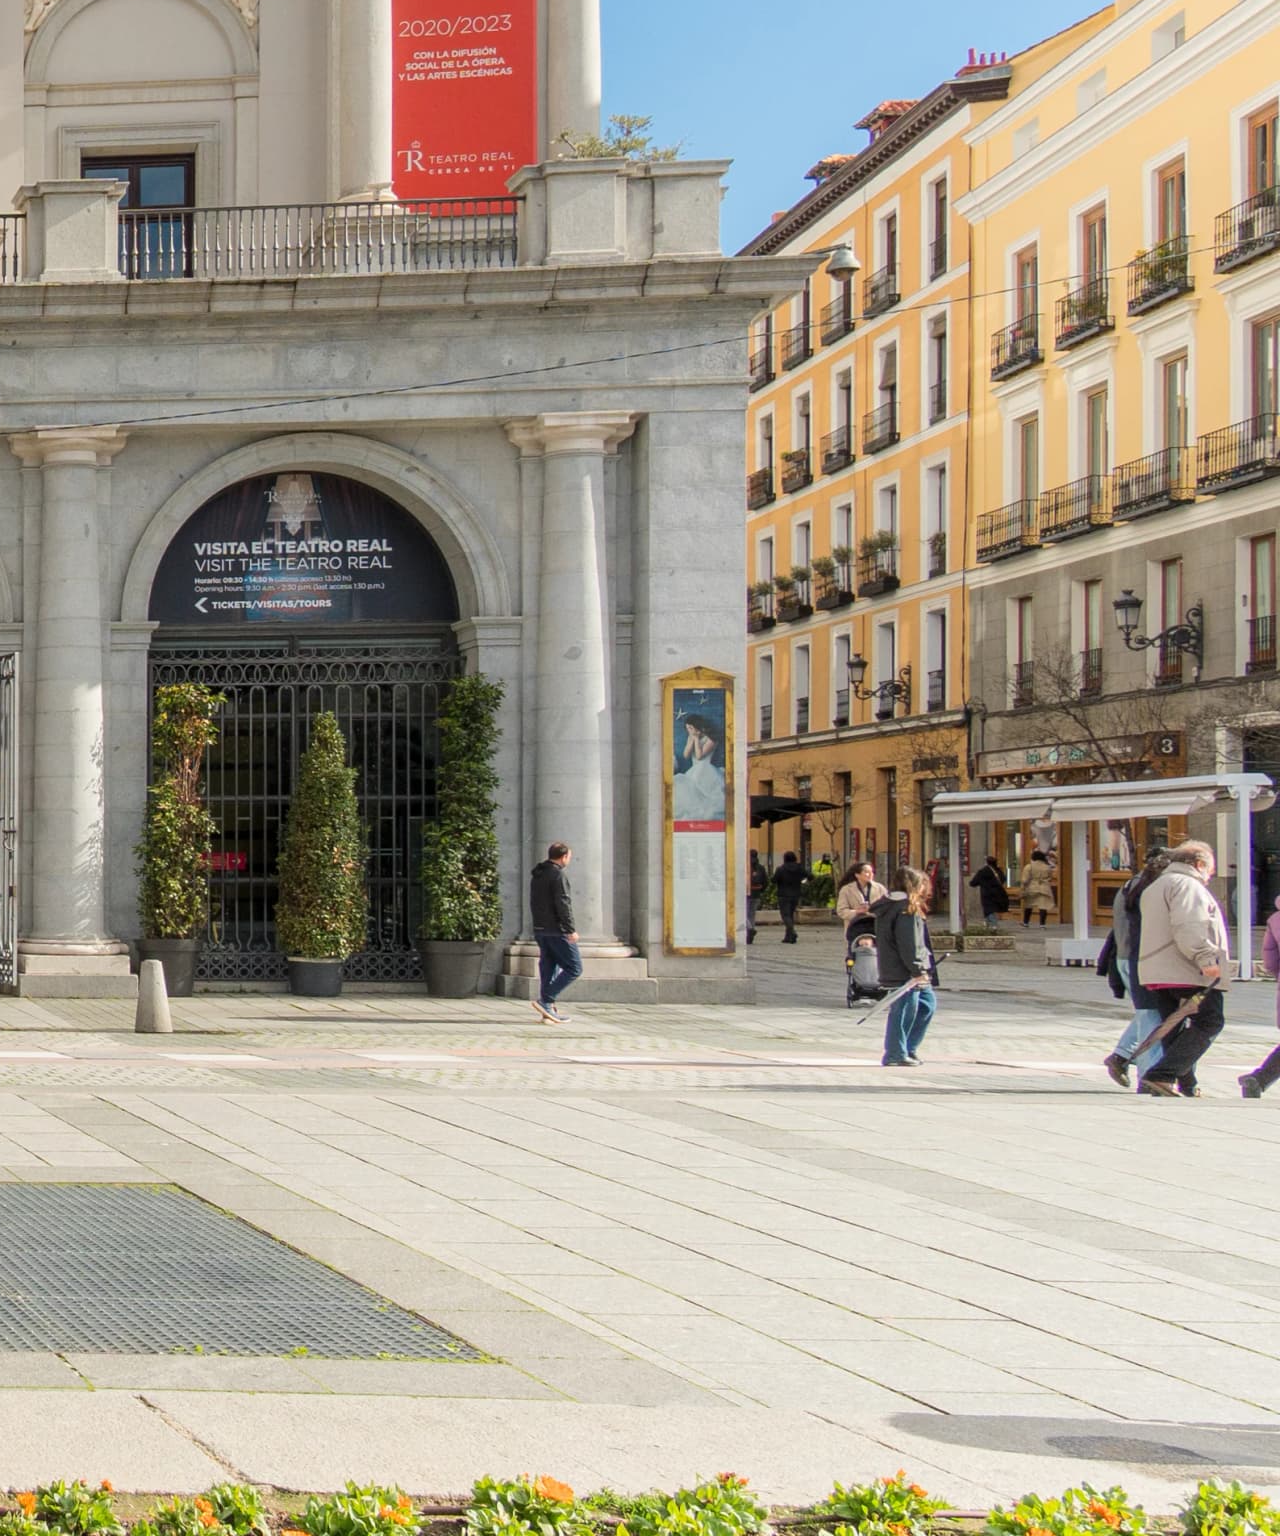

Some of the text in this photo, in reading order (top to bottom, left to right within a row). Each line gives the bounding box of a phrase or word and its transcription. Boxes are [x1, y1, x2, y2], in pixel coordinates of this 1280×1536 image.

[399, 14, 512, 38] 2020/2023
[413, 46, 497, 60] CON LA DIFUSIÓN
[405, 56, 505, 71] SOCIAL DE LA ÓPERA
[398, 66, 512, 81] Y LAS ARTES ESCÉNICAS
[429, 152, 514, 164] TEATRO REAL
[194, 539, 393, 555] VISITA EL TEATRO REAL
[195, 556, 392, 572] VISIT THE TEATRO REAL
[212, 599, 332, 609] TICKETS/VISITAS/TOURS
[1161, 739, 1173, 754] 3
